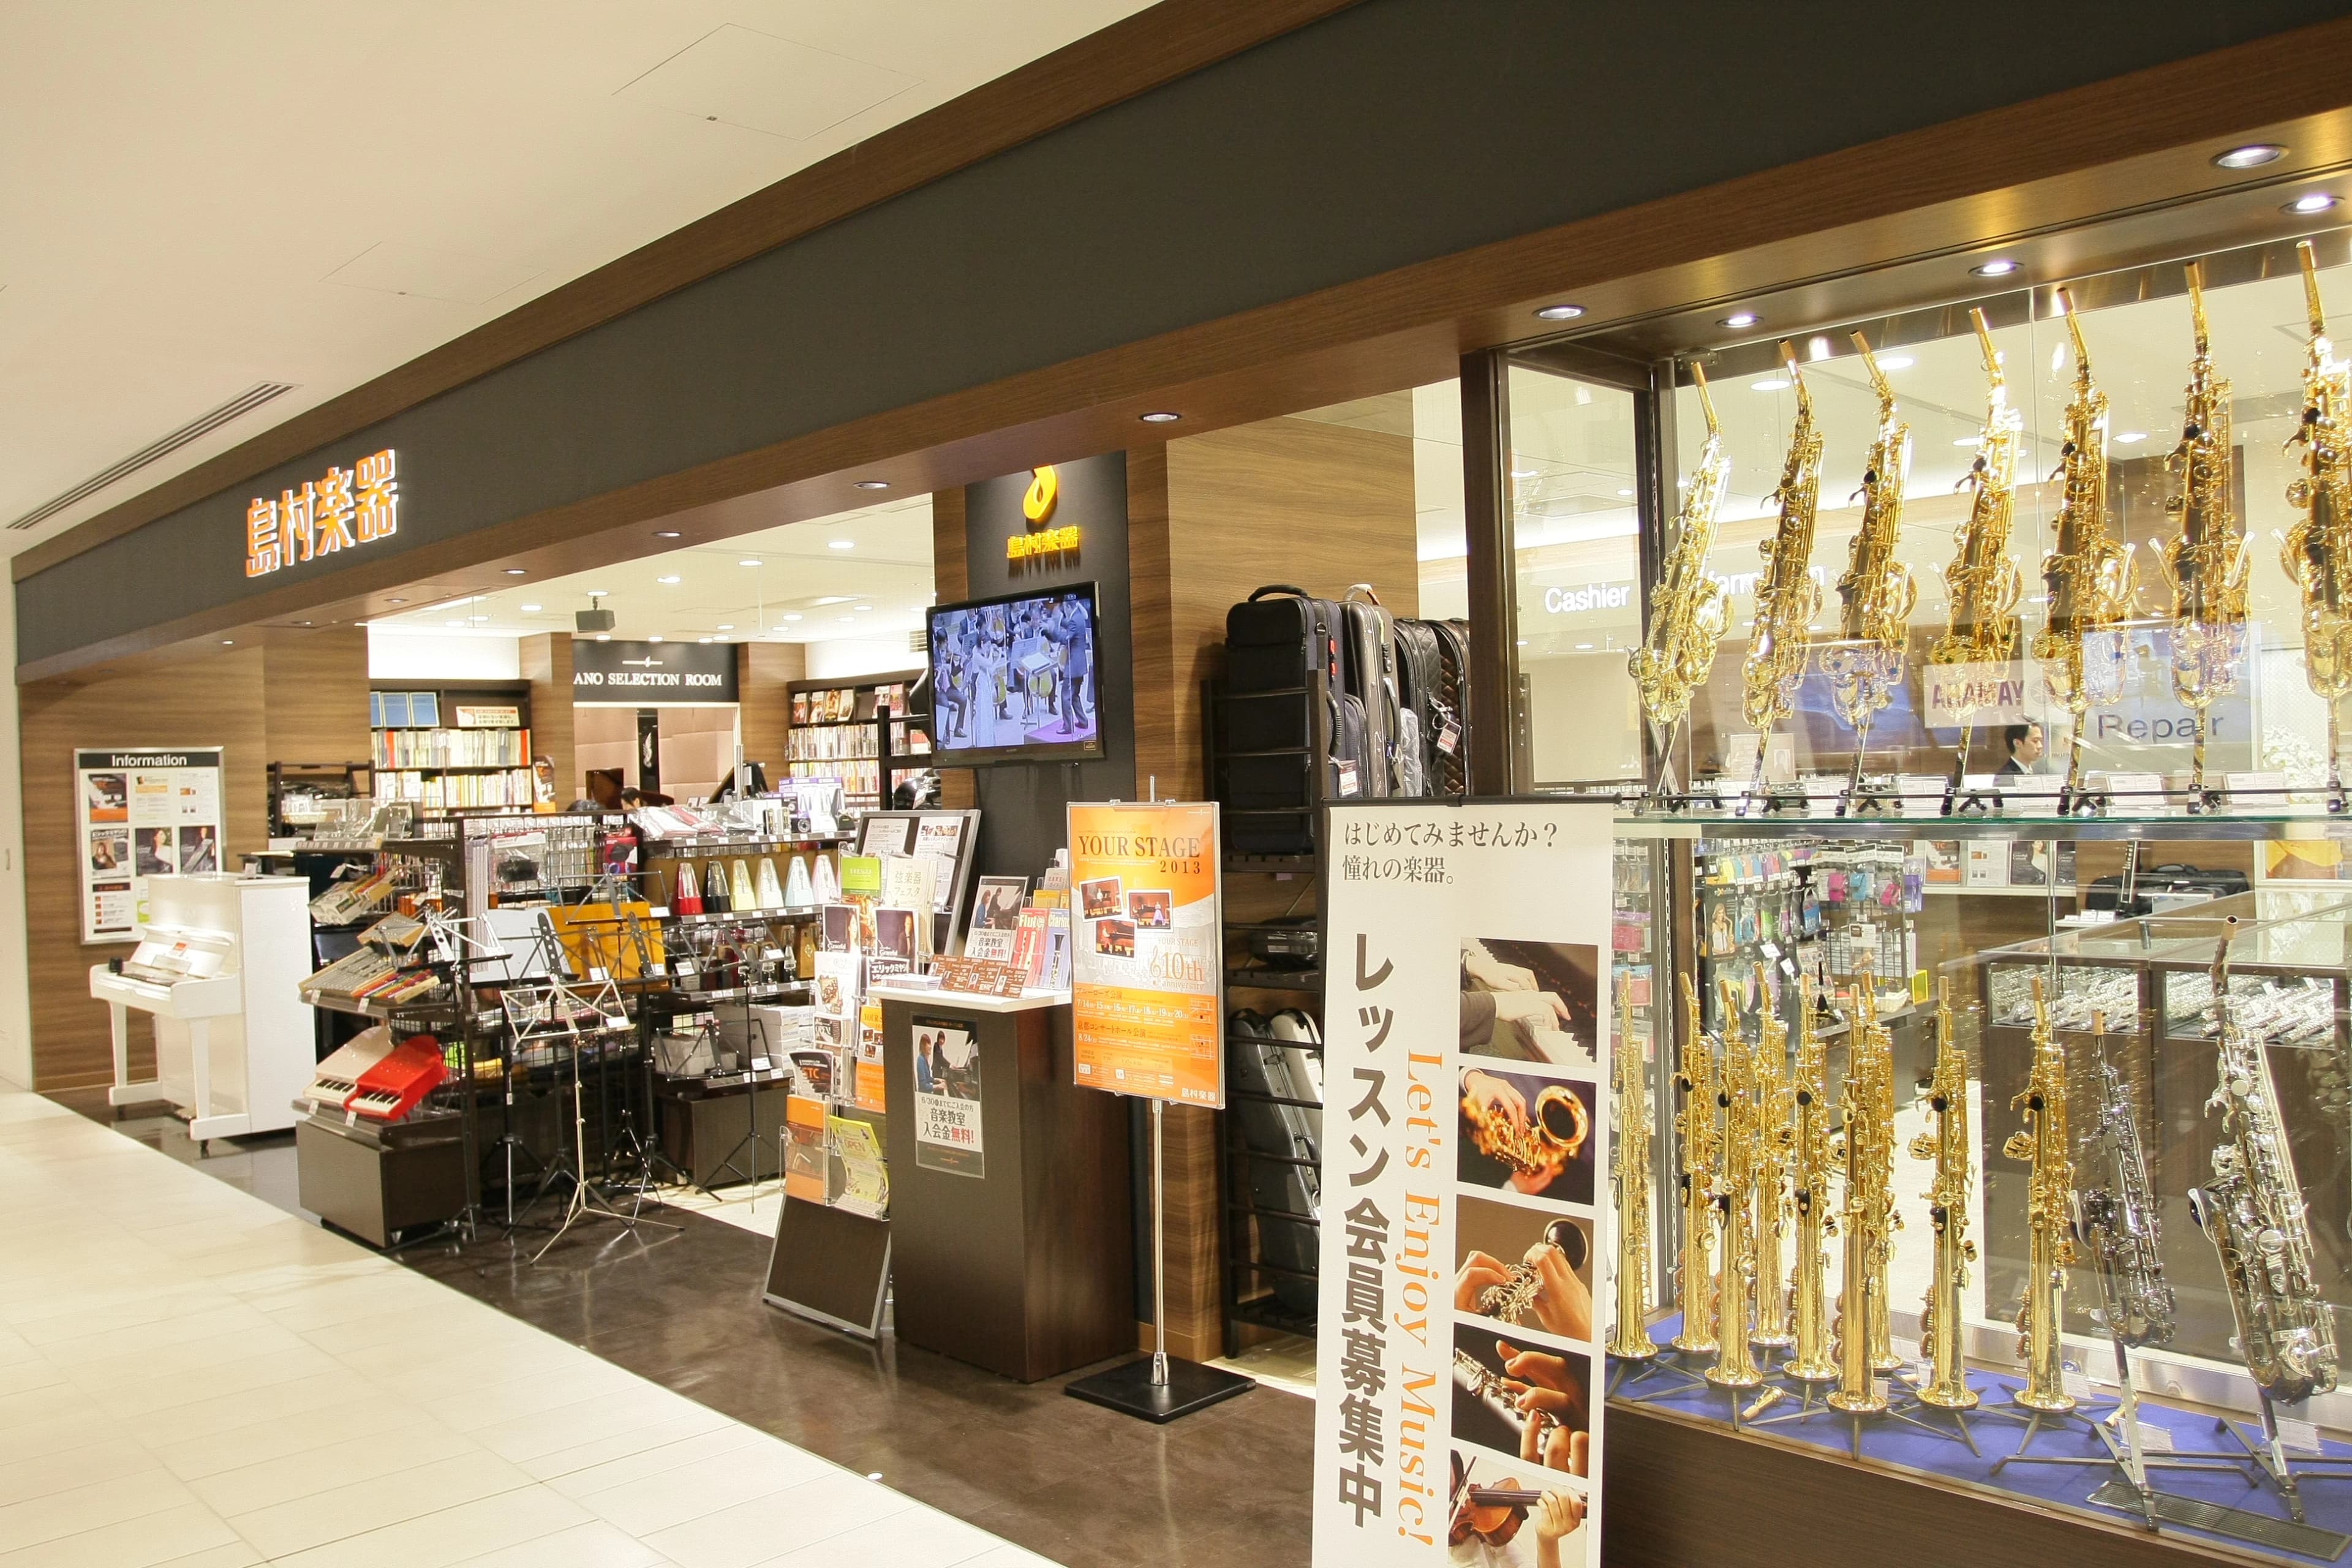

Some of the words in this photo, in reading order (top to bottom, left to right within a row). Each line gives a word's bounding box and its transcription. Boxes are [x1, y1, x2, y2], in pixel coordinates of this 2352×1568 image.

[246, 449, 399, 578] 島村楽器
[1006, 525, 1079, 558] 島村楽器
[1545, 582, 1630, 614] Cashier
[608, 673, 680, 686] SELECTION
[685, 674, 722, 687] ROOM
[2097, 714, 2225, 744] Repar
[112, 754, 187, 767] Information
[1078, 835, 1130, 856] YOUR
[1134, 837, 1200, 858] STAGE
[1344, 821, 1558, 848] はじめてみませんか?
[1159, 861, 1200, 874] 2013
[1342, 855, 1454, 885] 憧れの楽器。
[1177, 938, 1199, 947] STAGE
[1181, 1087, 1216, 1102] 島村楽器
[930, 1107, 966, 1127] 音楽教室
[1405, 1048, 1443, 1170] Let's
[922, 1121, 975, 1145] 入会金無料!
[1338, 933, 1394, 1529] レッスン会員募集中
[1393, 1188, 1441, 1349] Enjoy
[1396, 1362, 1436, 1547] Music!
